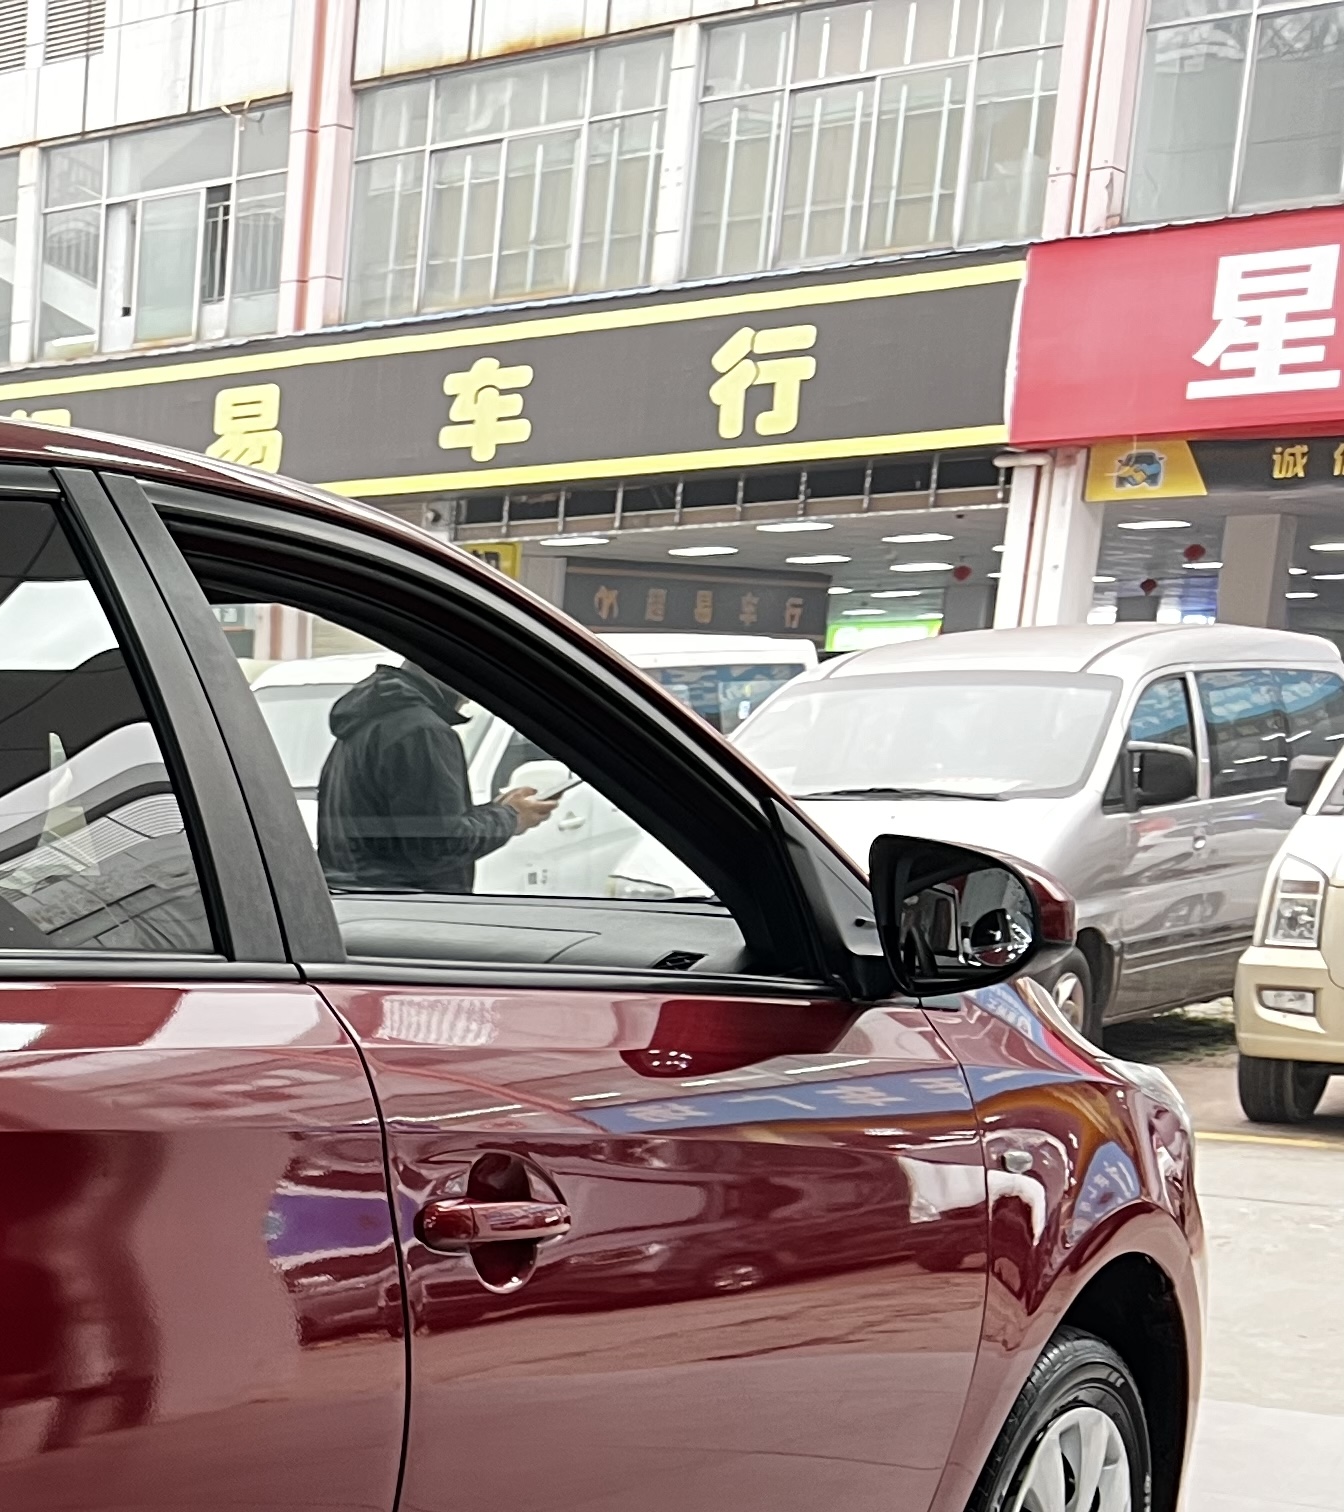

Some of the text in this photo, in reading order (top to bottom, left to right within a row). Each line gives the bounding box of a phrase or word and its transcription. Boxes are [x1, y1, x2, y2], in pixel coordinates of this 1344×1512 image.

[1185, 243, 1342, 400] 星
[11, 324, 818, 475] 易车行
